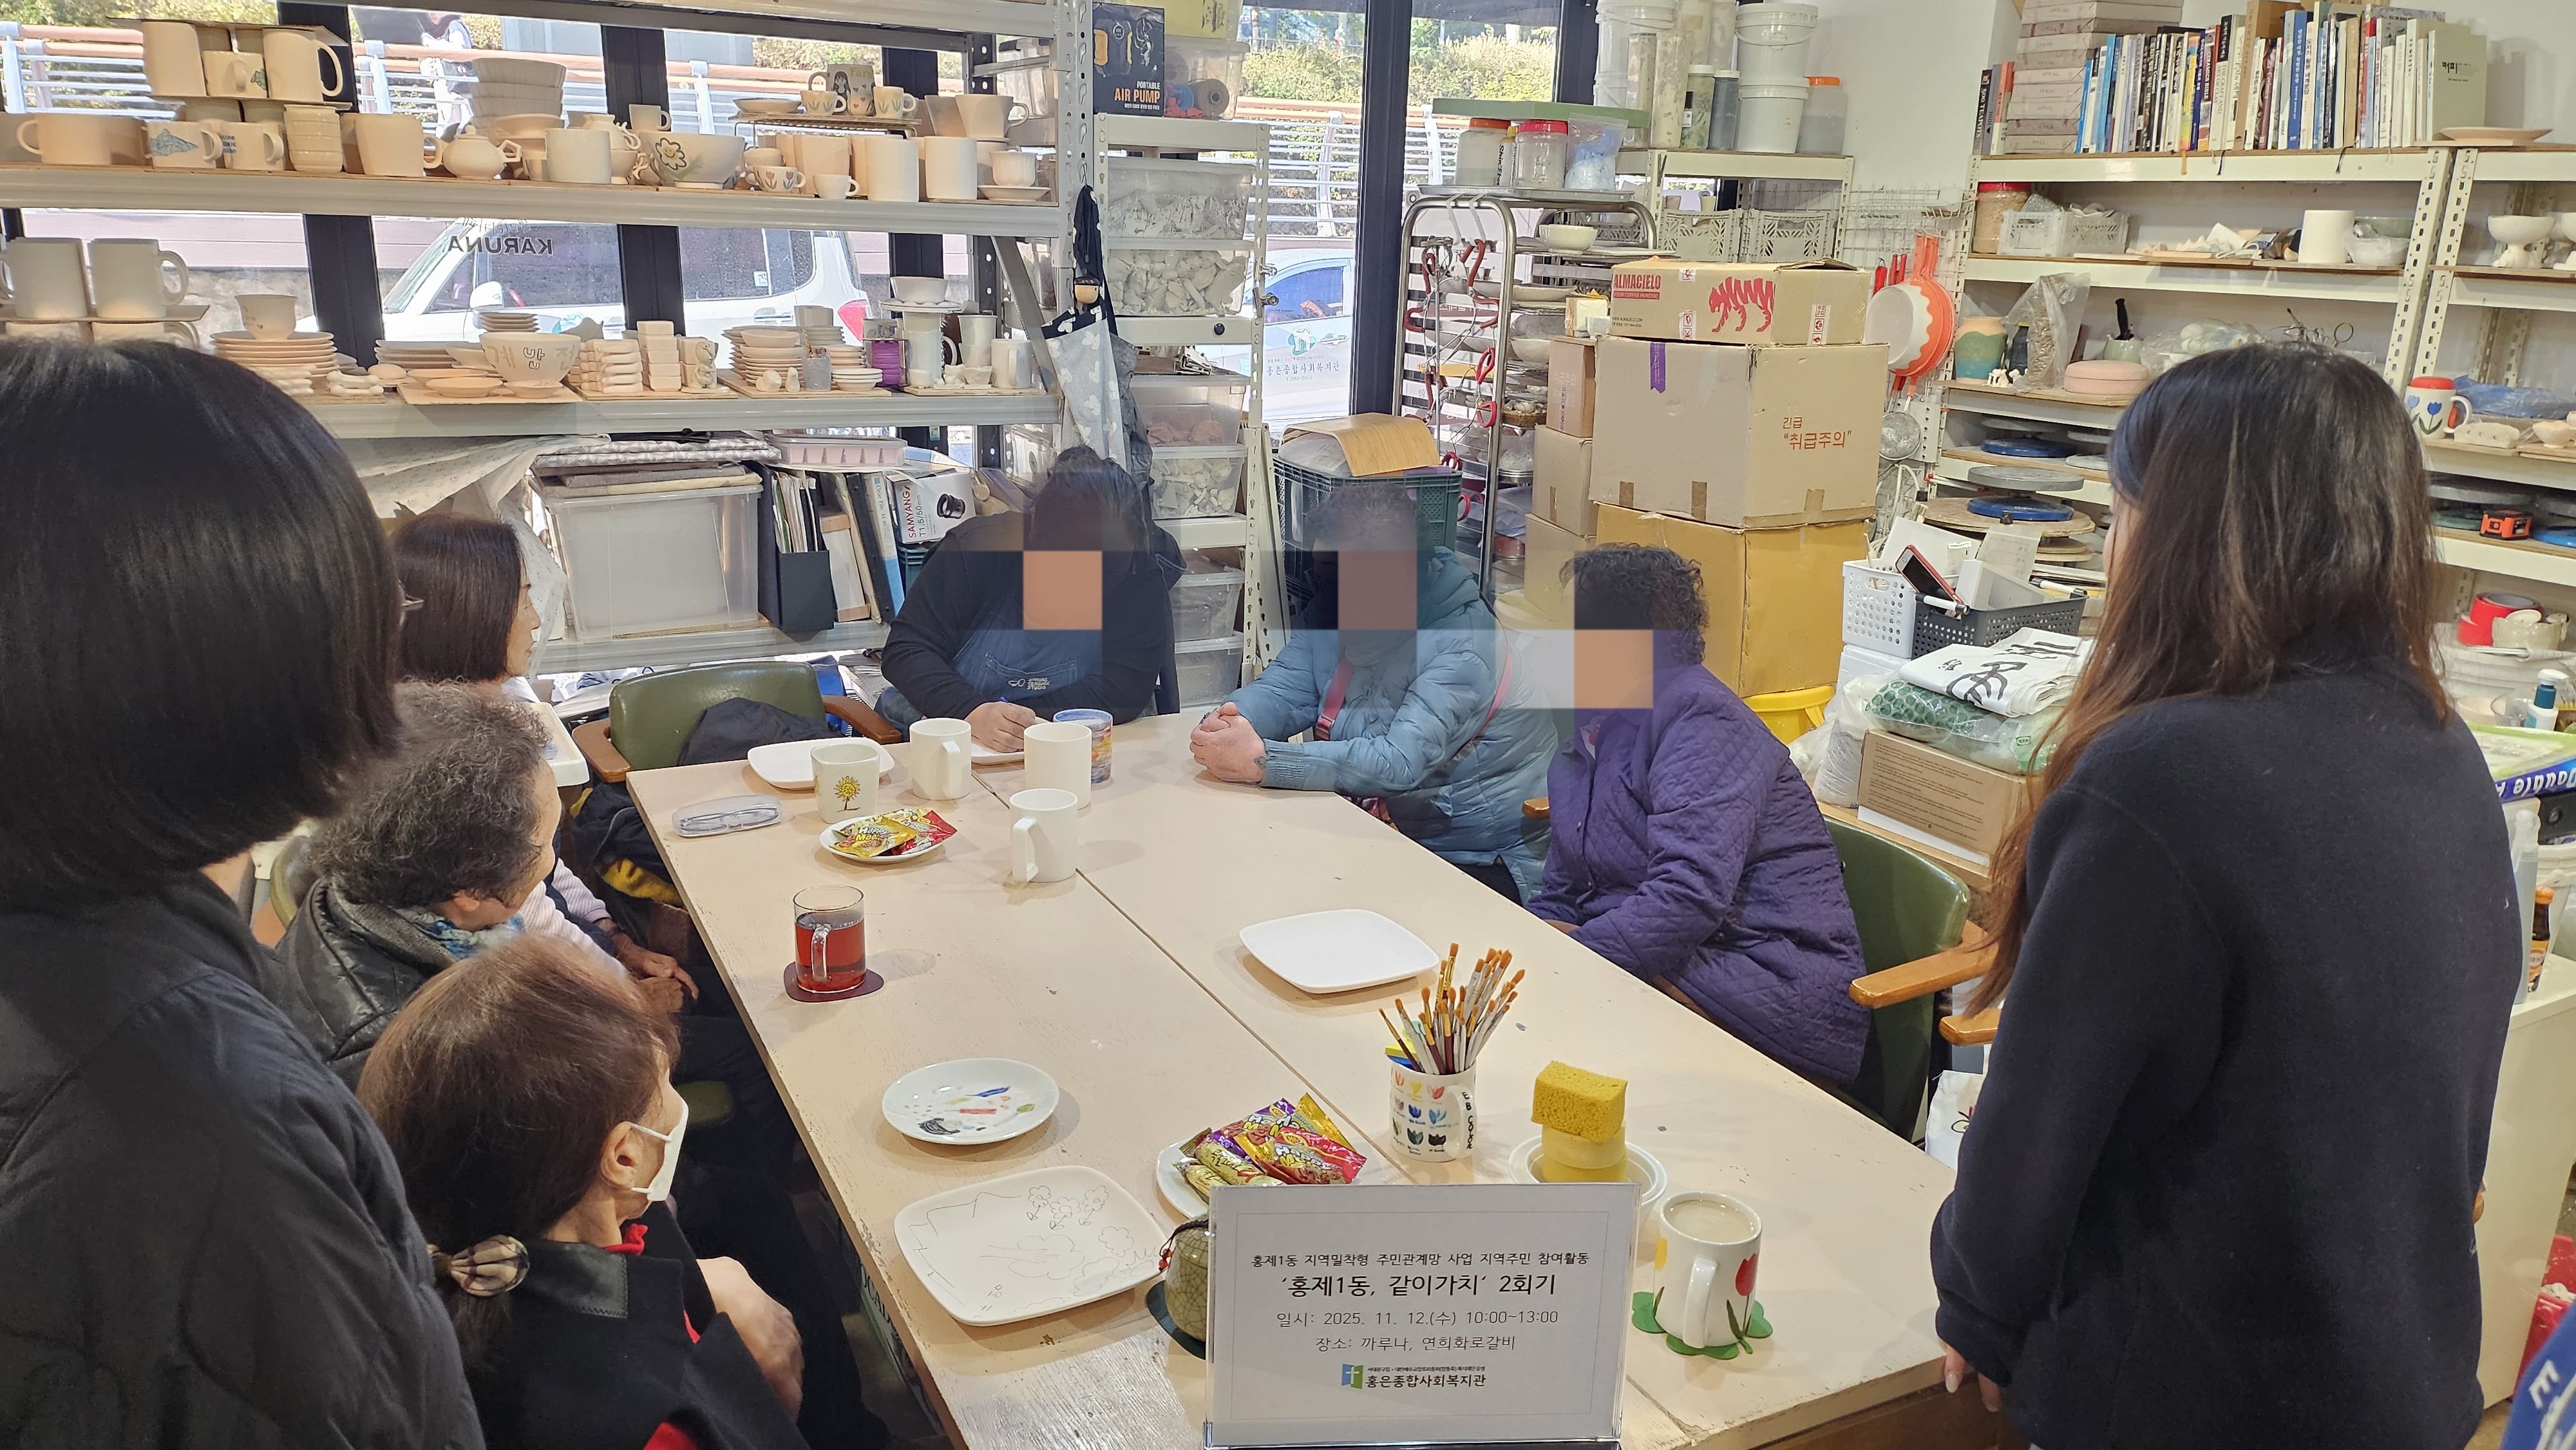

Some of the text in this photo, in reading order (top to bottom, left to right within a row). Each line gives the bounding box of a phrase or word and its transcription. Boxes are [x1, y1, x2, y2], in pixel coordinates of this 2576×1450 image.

[1136, 80, 1160, 89] PORTABLE
[1114, 88, 1160, 104] AIR PUMP
[1976, 103, 1985, 138] TEAPOTS
[1613, 274, 1662, 290] ALMACIELO
[1266, 361, 1340, 376] 홍은종합사회복지관
[1783, 417, 1803, 429] 긴급
[1783, 429, 1852, 451] "취급주의"
[902, 490, 916, 538] SAMYANG
[915, 494, 926, 538] T1.5/50mm
[1251, 1252, 1589, 1268] 홍제1동 지역밀착형 주민관계망 사업 지역주민 참여활동
[1499, 1274, 1555, 1295] 2회기
[1276, 1310, 1558, 1328] 일시: 2025. 11. 12.(수) 10:00~13:00
[1315, 1335, 1515, 1352] 장소: 까루나, 연희화로갈비
[1365, 1374, 1486, 1388] 홍은종합사회복지관
